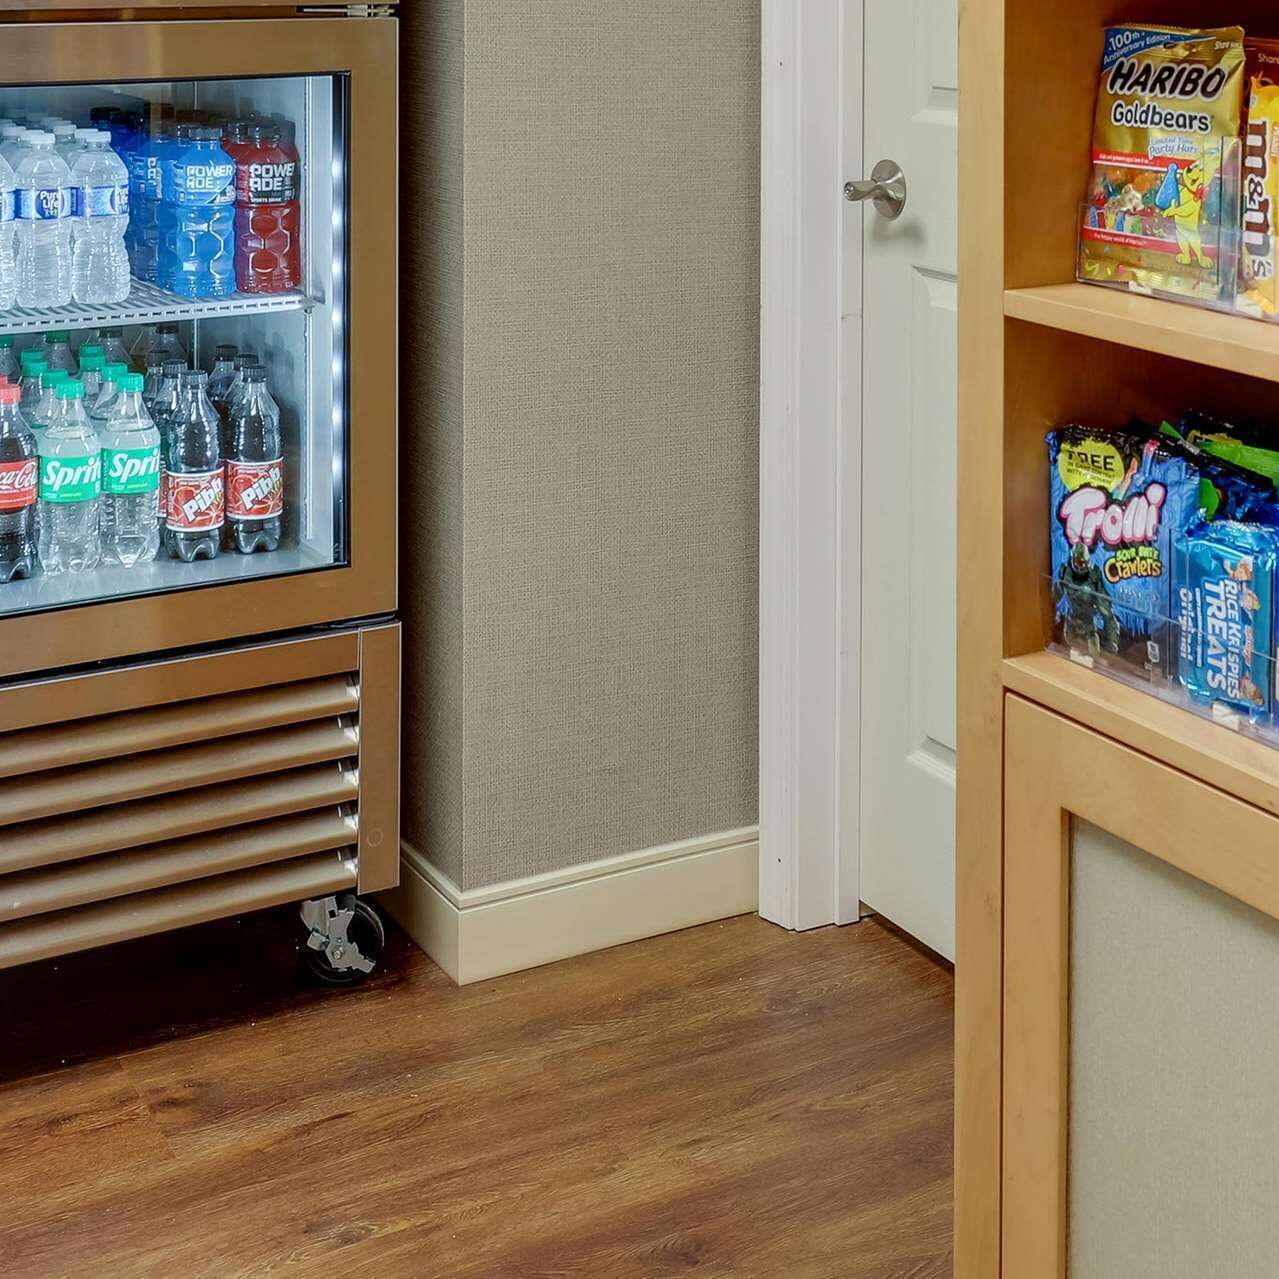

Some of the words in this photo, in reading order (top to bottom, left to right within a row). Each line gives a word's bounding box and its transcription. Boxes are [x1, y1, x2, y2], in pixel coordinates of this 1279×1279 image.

[1103, 40, 1145, 65] Anniversary
[1146, 33, 1171, 45] Edition
[1107, 57, 1228, 102] HARIBO
[1111, 100, 1211, 135] Goldbears
[40, 190, 61, 201] Pure
[42, 198, 60, 211] Life
[1066, 448, 1116, 472] FREE
[1059, 482, 1167, 547] Trolli
[1104, 557, 1163, 584] Crawlers
[1224, 579, 1239, 621] RICE
[1204, 580, 1228, 691] TREATS
[1225, 620, 1241, 700] KRISPIES
